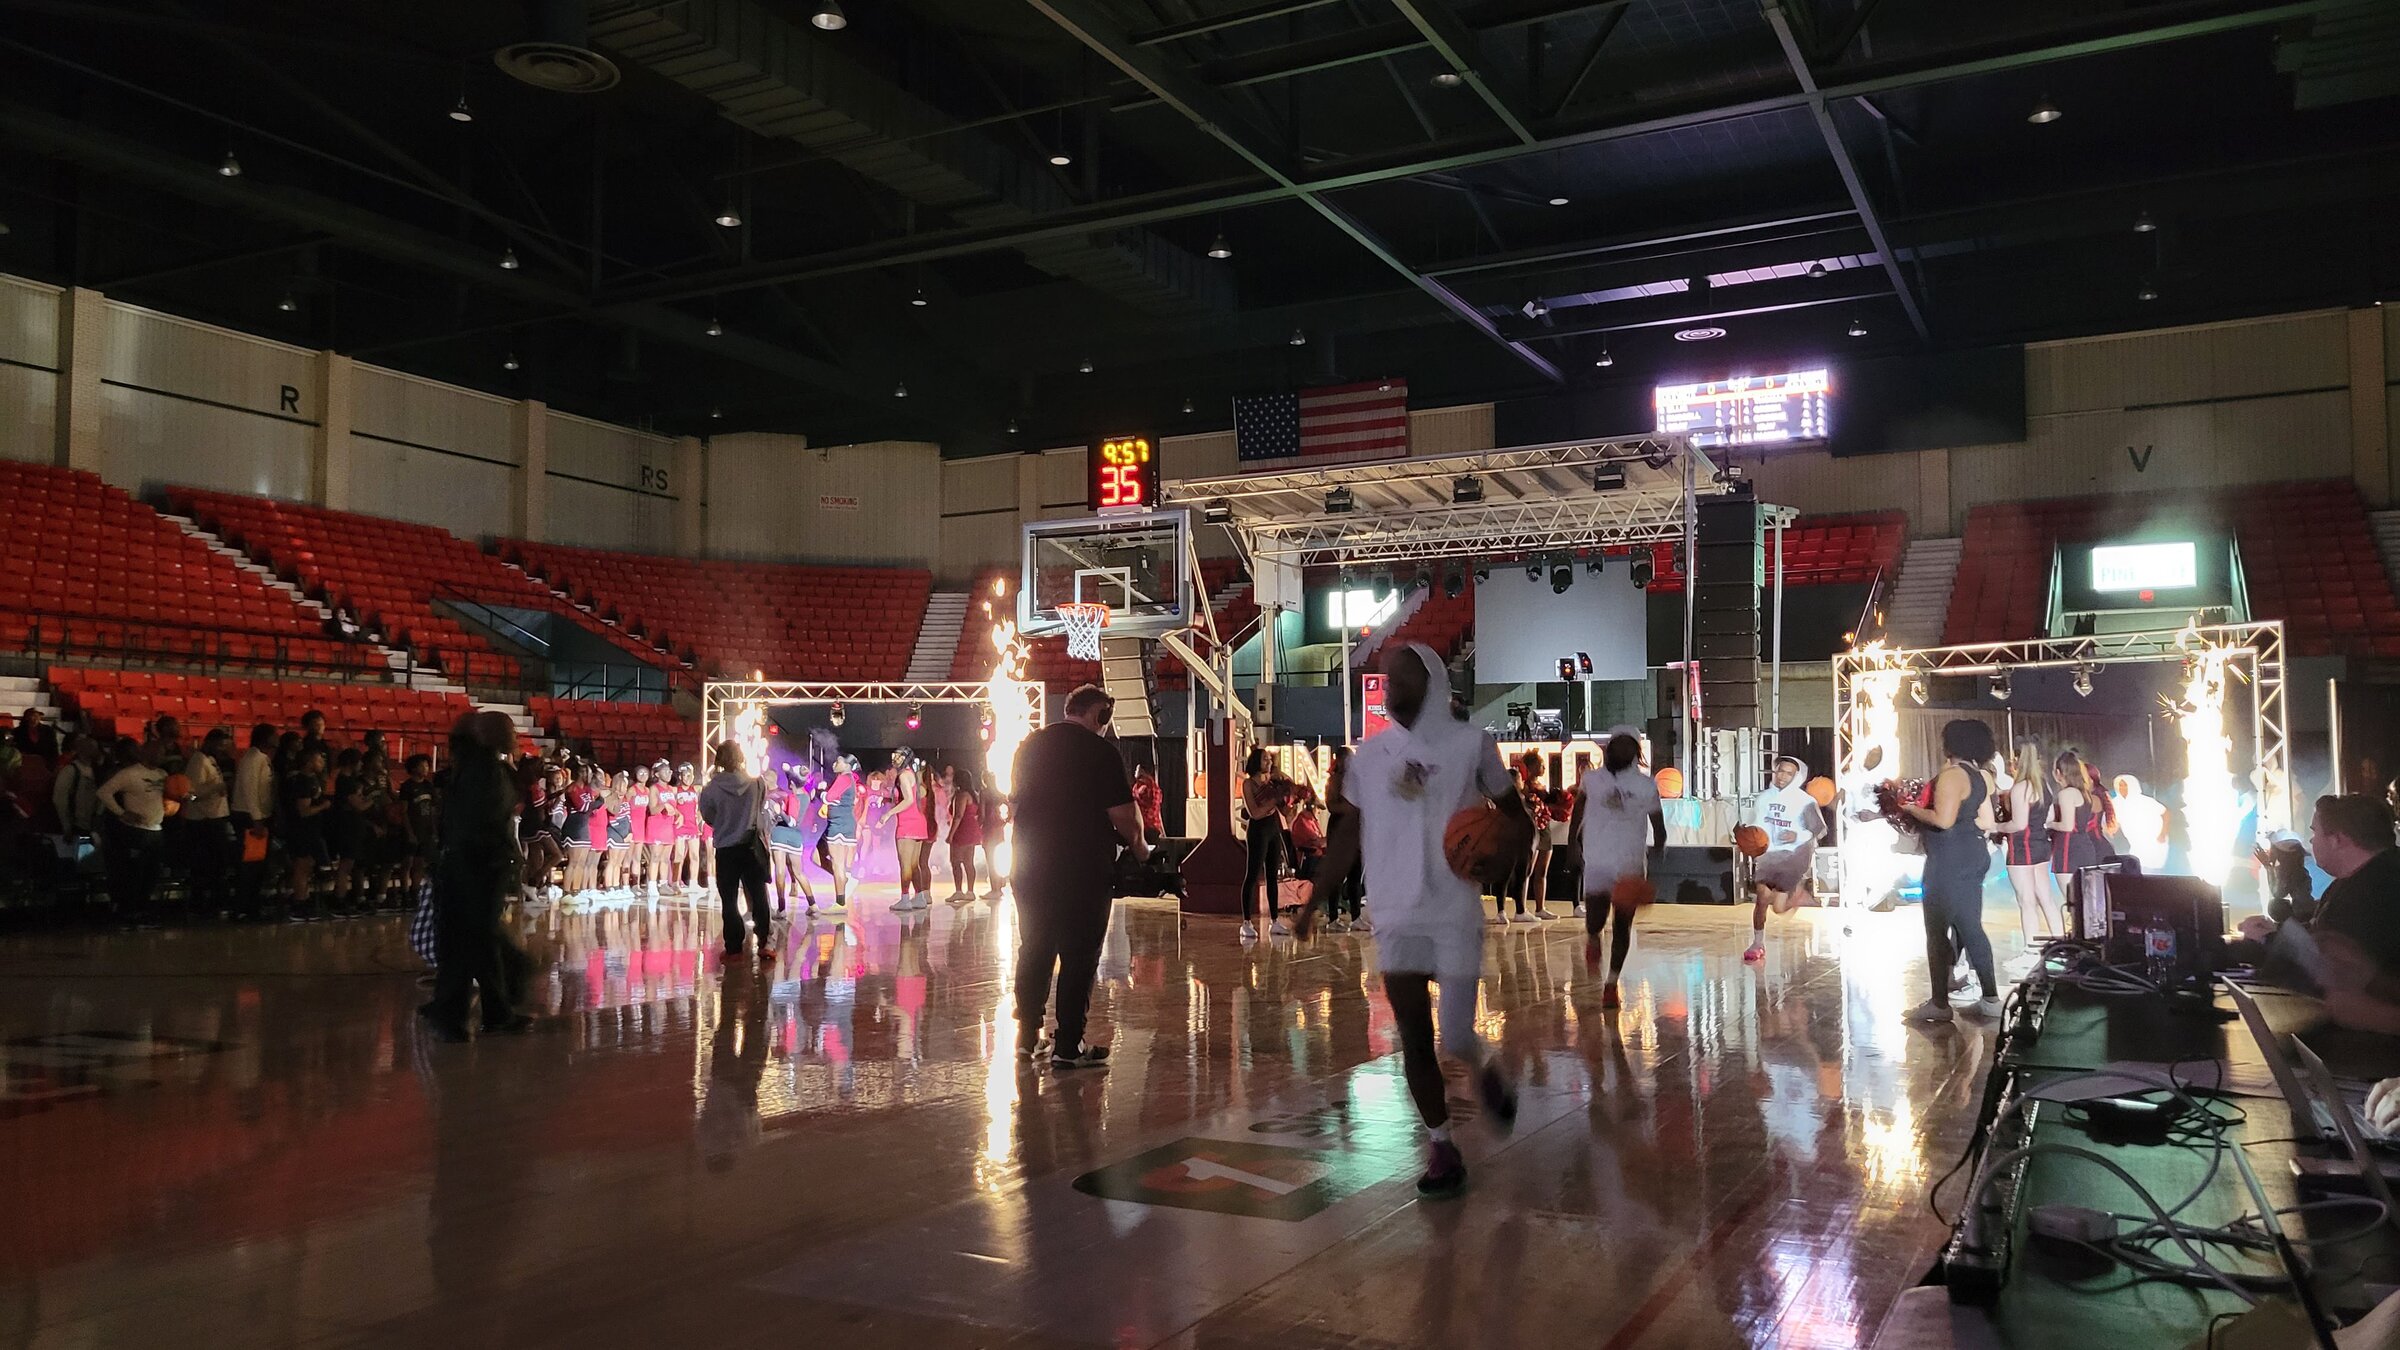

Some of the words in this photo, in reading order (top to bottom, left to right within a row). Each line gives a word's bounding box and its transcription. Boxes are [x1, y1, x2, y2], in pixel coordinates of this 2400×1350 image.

[281, 385, 299, 413] R
[1104, 440, 1149, 464] 9:57
[2128, 445, 2153, 472] V
[642, 465, 668, 490] RS
[1102, 465, 1140, 504] 35
[820, 496, 830, 504] NO
[830, 497, 858, 506] SMOKING
